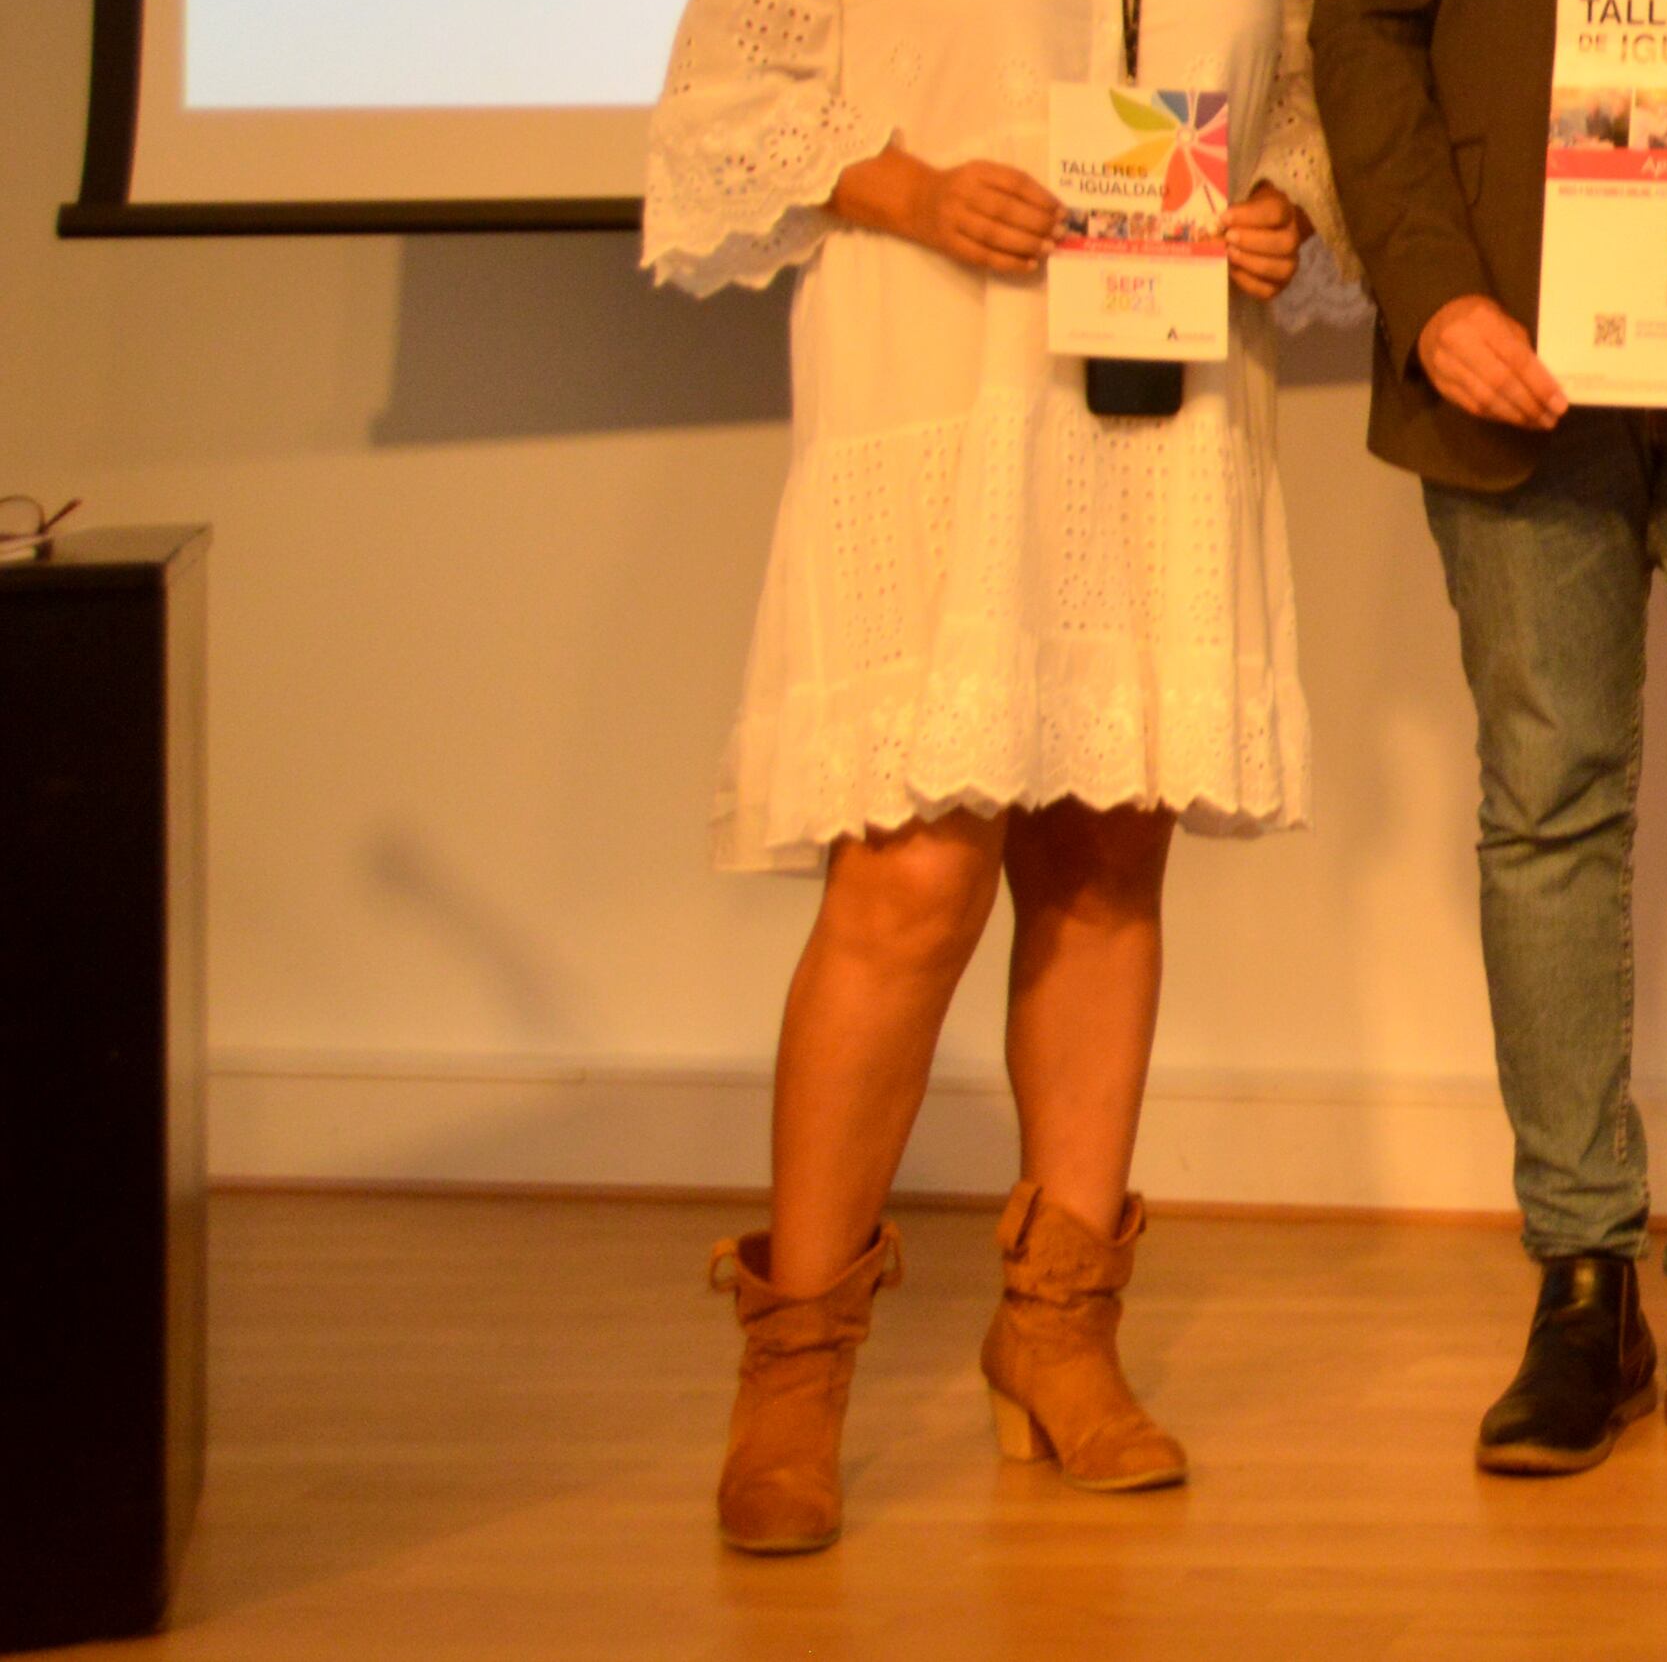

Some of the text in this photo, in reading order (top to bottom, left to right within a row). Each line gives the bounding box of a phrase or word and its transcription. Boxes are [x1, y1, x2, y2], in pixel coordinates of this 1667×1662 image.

[1578, 33, 1608, 55] DE
[1060, 159, 1149, 180] TALLERES
[1079, 179, 1171, 197] IGUALDAD
[1105, 275, 1155, 294] SEPT
